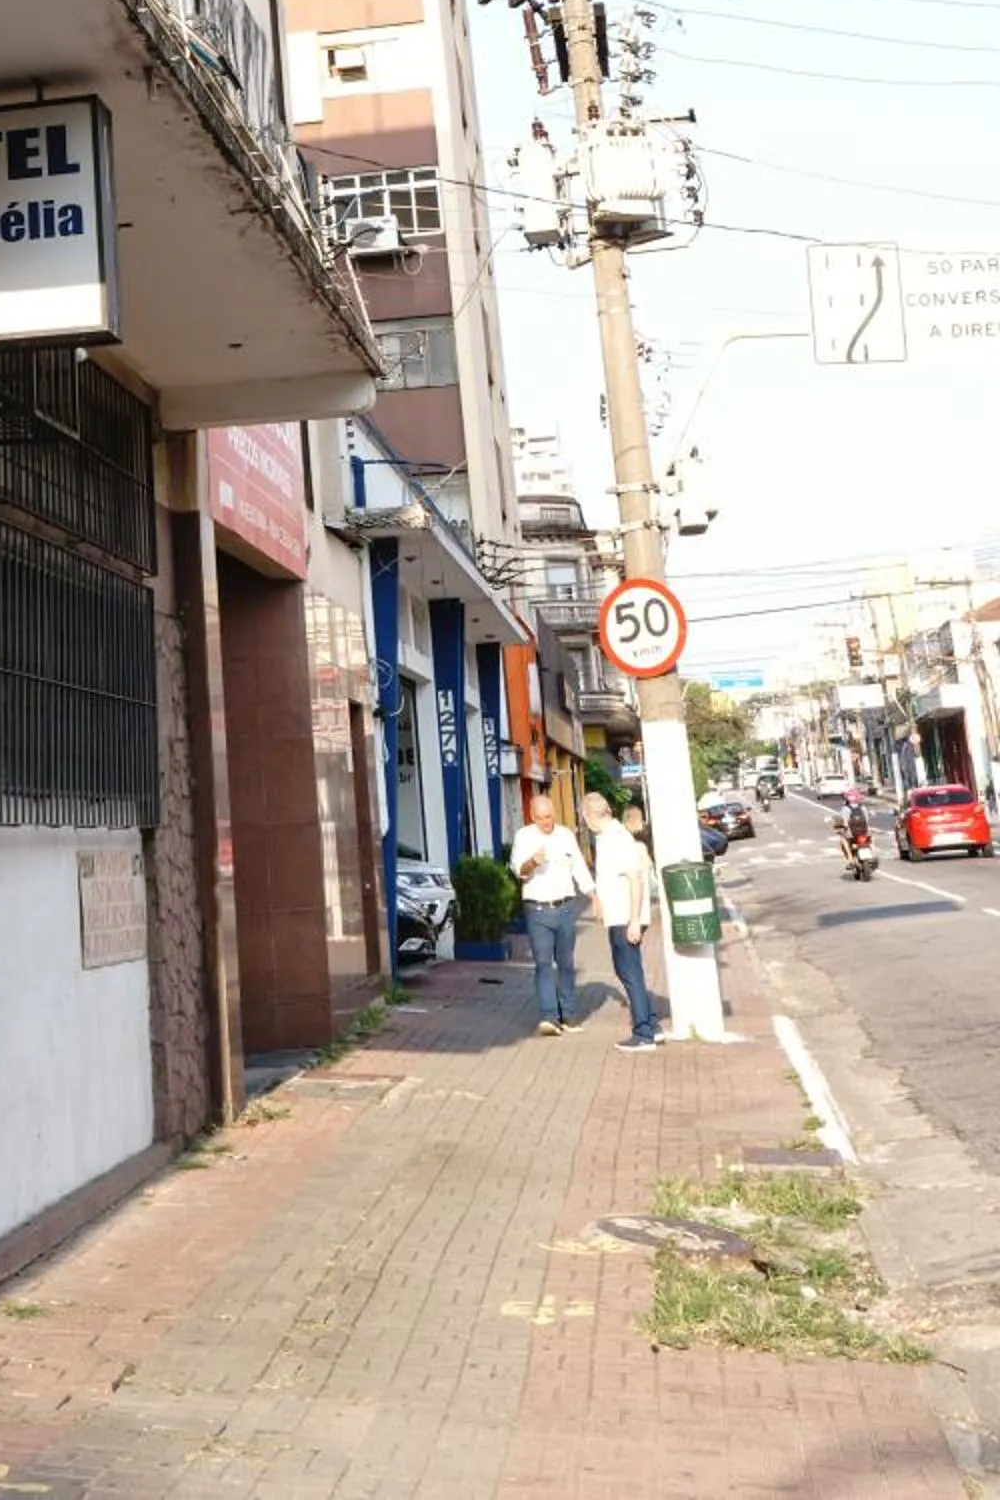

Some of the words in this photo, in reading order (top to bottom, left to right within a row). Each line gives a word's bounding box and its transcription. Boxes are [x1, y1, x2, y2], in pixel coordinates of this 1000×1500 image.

[961, 258, 999, 273] PAR
[906, 289, 1000, 307] CONVERS
[929, 324, 941, 338] A
[951, 322, 1000, 338] DIRE
[616, 598, 669, 643] 50
